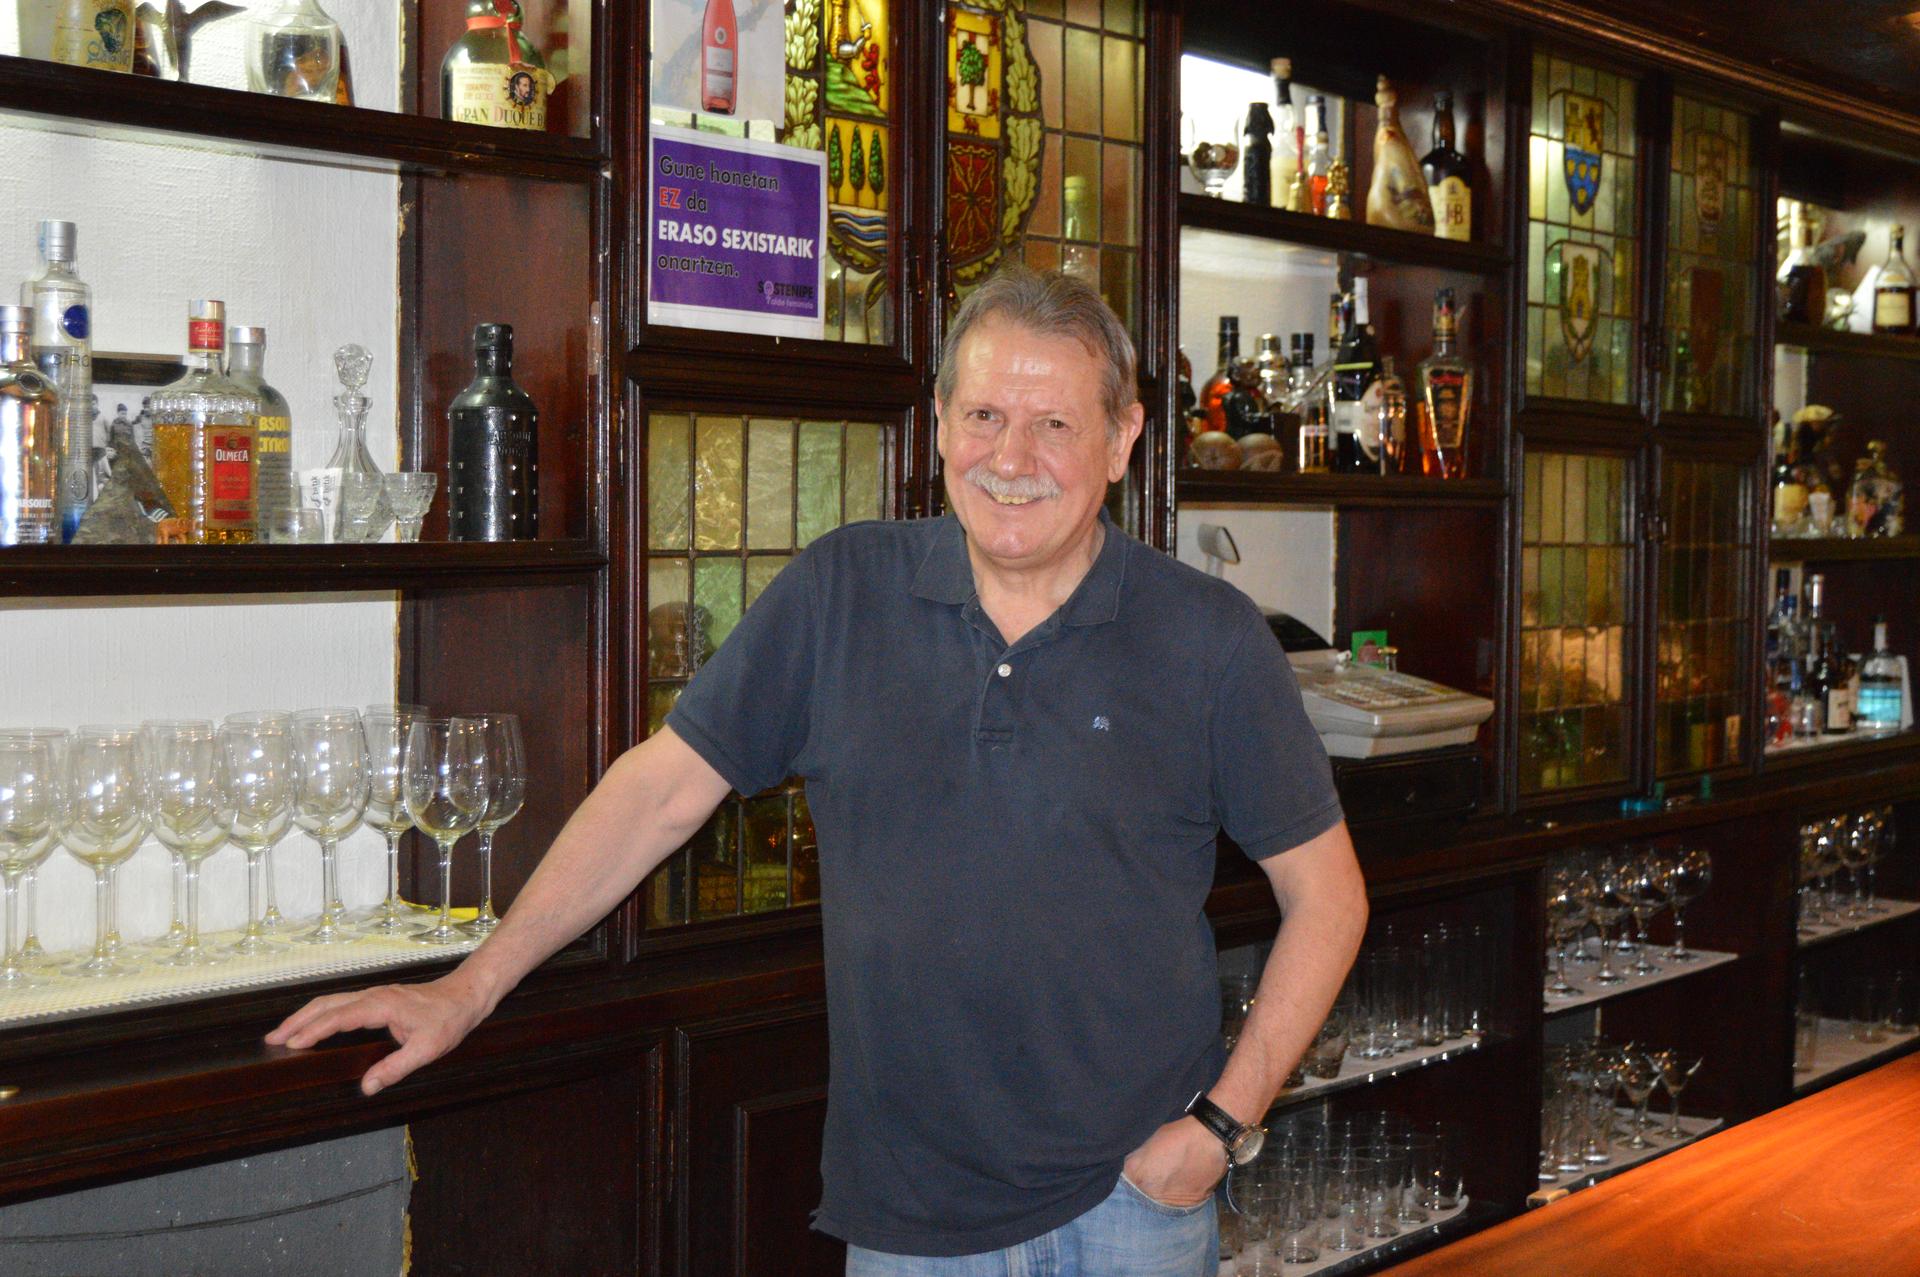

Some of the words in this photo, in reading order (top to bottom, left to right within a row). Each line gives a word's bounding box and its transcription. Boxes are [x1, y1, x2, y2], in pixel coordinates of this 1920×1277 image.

[494, 105, 536, 127] DUQUE
[659, 155, 705, 180] Gune
[710, 161, 779, 191] honetan
[659, 186, 682, 209] EZ
[686, 190, 708, 212] da
[658, 219, 717, 246] ERASO
[721, 228, 814, 259] SEXISTARIK
[657, 255, 740, 278] onartzen.
[215, 448, 249, 462] OLMECA
